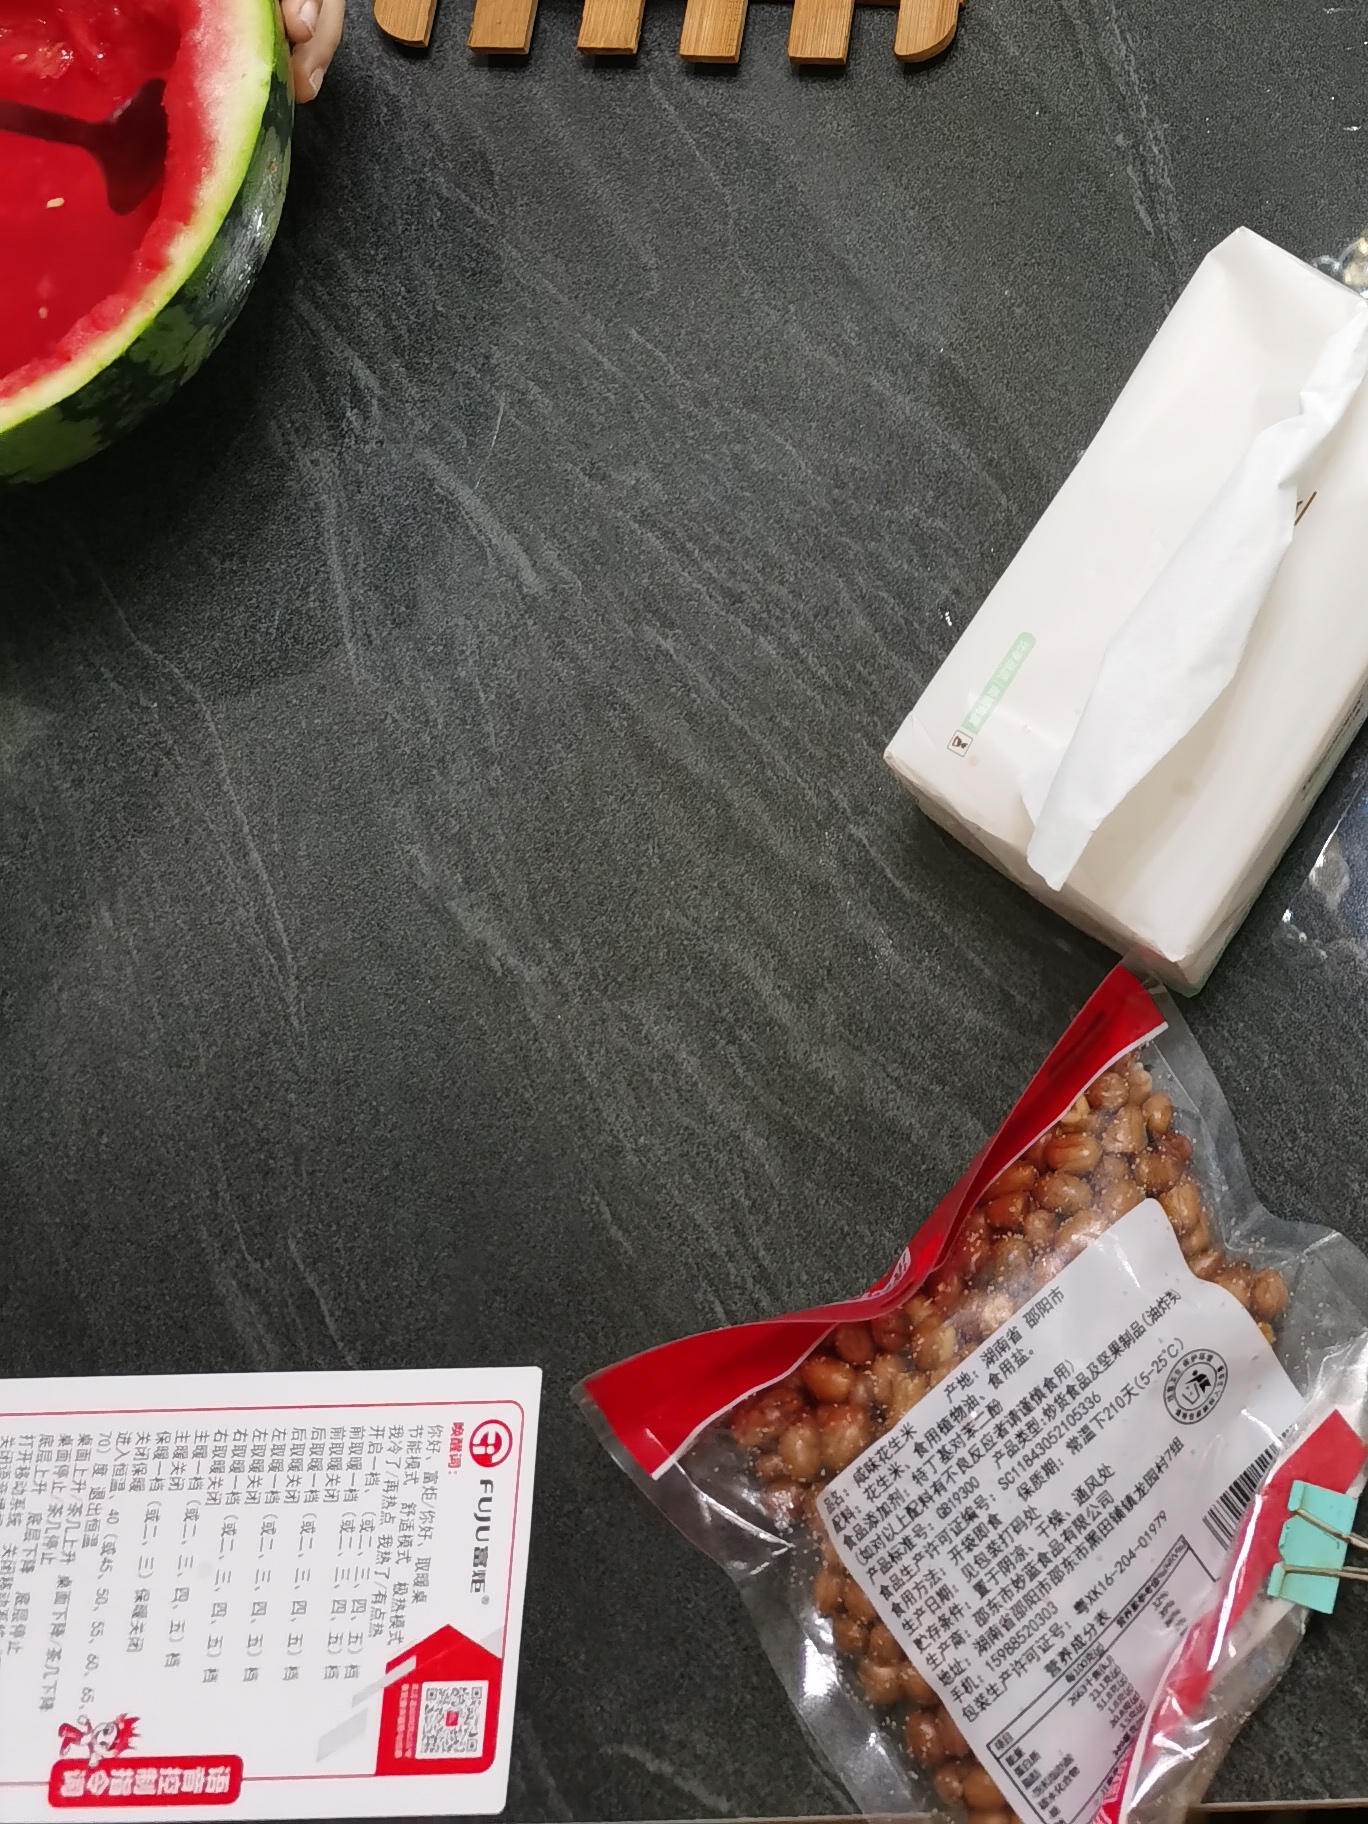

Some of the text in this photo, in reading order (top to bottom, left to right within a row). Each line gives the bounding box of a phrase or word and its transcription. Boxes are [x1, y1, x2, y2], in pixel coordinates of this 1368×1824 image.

[128, 1430, 152, 1491] 关闭保暖
[168, 1429, 190, 1490] 主暖关闭
[204, 1429, 229, 1505] 右取暖关闭
[243, 1428, 268, 1505] 左取暖关闭
[283, 1426, 307, 1504] 后取暖关闭
[322, 1425, 346, 1503] 前取暖关闭
[401, 1424, 423, 1485] 节能模式
[393, 1502, 416, 1564] 舒适模式
